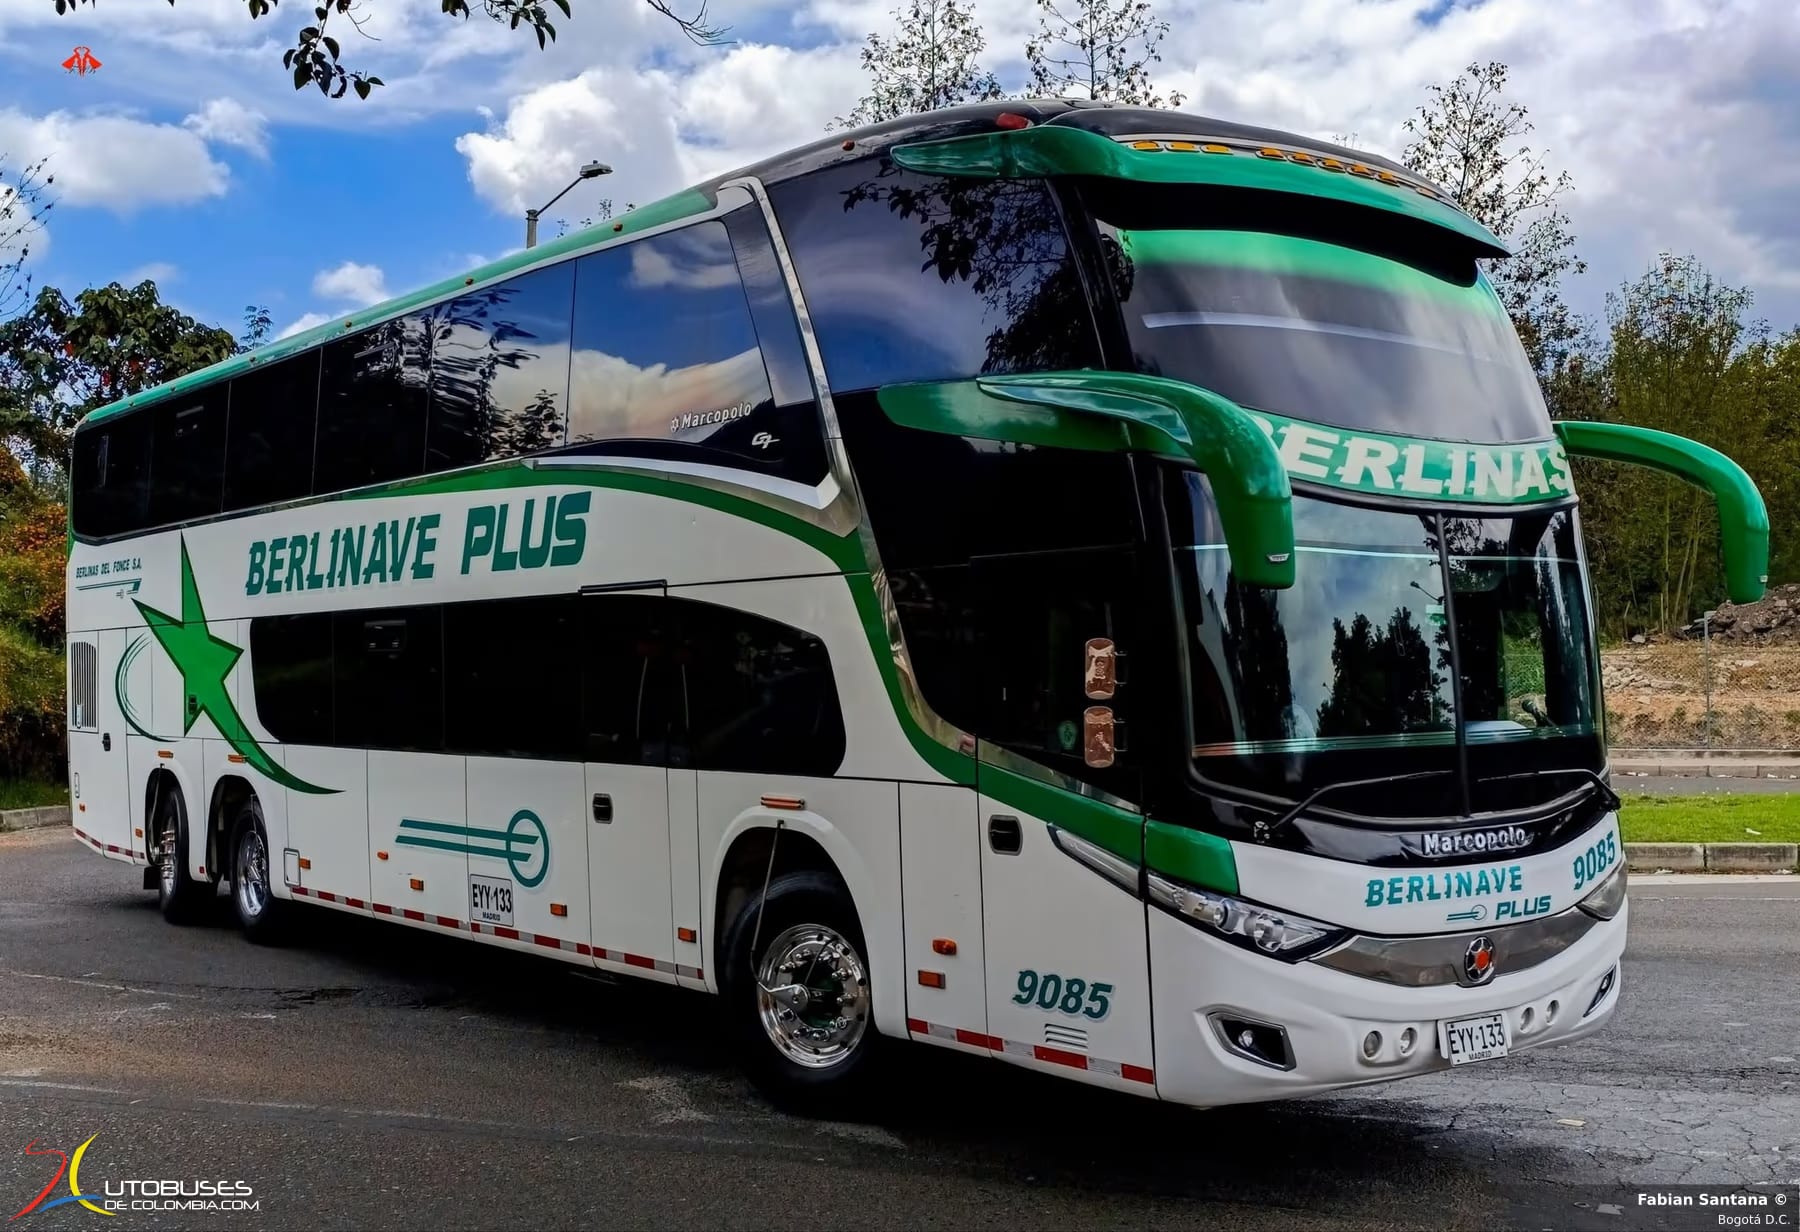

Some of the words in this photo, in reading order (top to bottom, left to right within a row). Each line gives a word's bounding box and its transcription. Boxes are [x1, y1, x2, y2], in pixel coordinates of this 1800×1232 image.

[681, 402, 752, 428] Marcopolo
[1253, 415, 1569, 497] ERLINAS
[246, 513, 441, 597] BERLINAVE
[461, 491, 592, 575] PLUS
[76, 564, 99, 578] BERLINAS
[101, 562, 110, 575] DEL
[113, 558, 130, 572] FONCE
[1422, 826, 1527, 855] Marcopolo
[1573, 830, 1615, 890] 9085
[1365, 866, 1522, 907] BERLINAVE
[1496, 895, 1551, 920] PLUS
[1012, 970, 1113, 1019] 9085
[1468, 1051, 1492, 1061] MADRID
